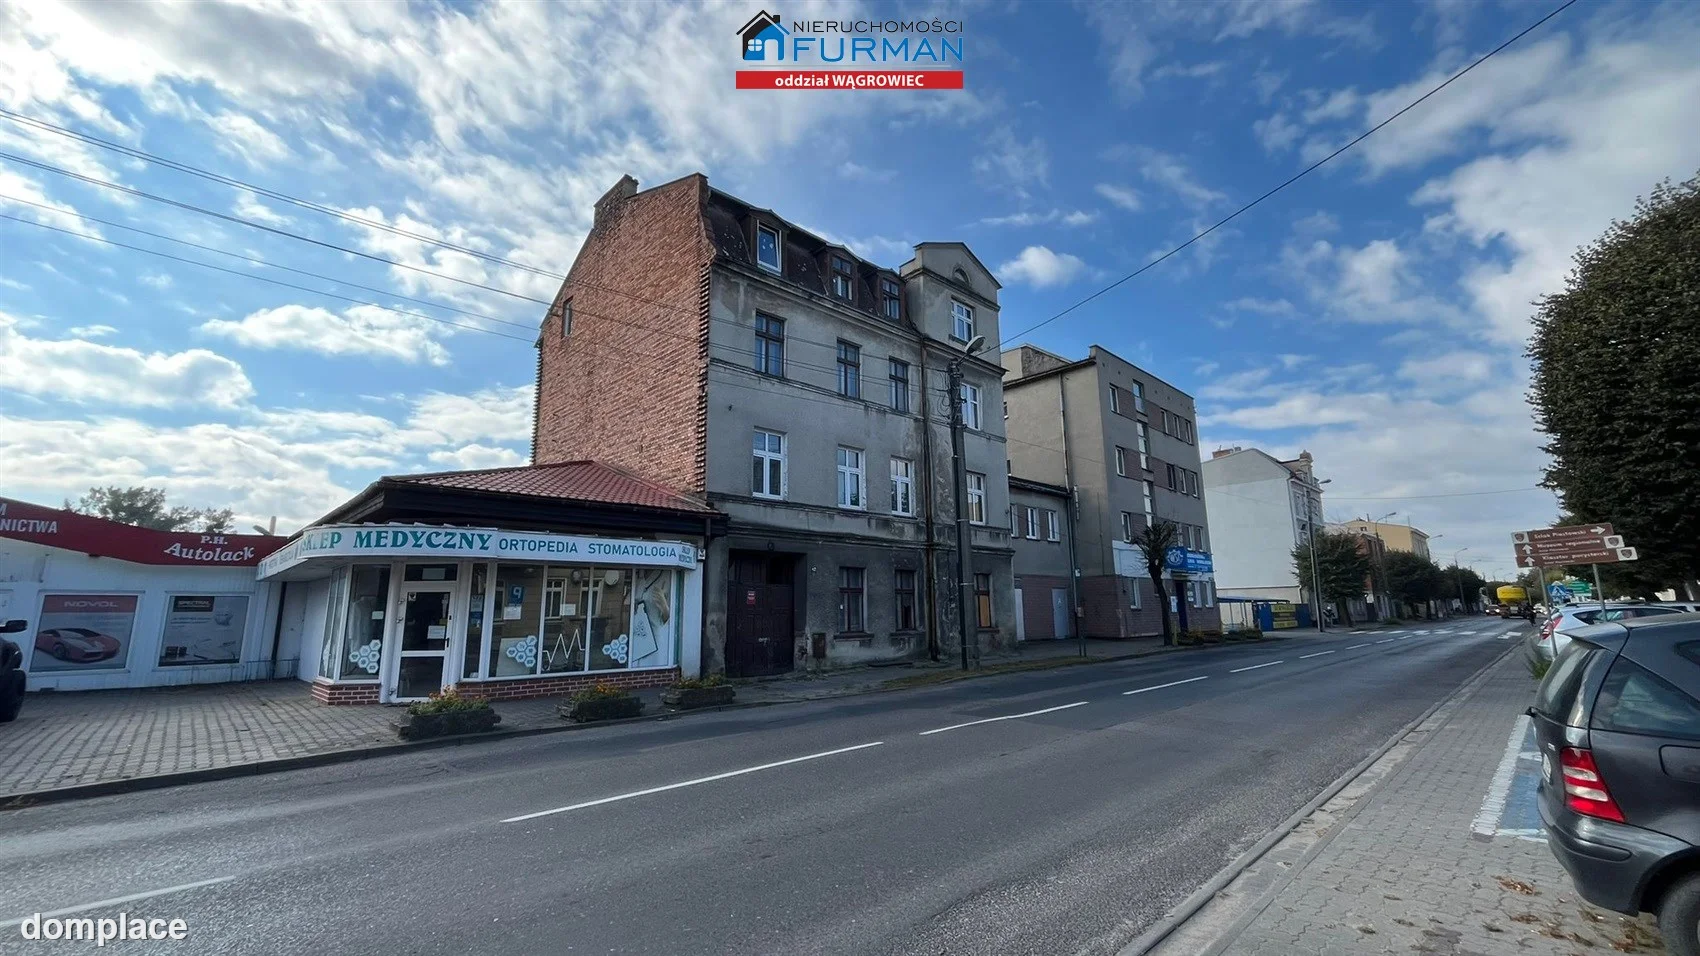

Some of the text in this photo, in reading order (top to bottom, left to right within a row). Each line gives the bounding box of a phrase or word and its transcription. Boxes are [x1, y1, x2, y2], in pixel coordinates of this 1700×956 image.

[200, 535, 228, 545] P.H.
[353, 530, 493, 550] MEDYCZNY
[498, 538, 578, 554] ORTOPEDIA
[587, 542, 677, 557] STOMATOLOGIA
[163, 542, 255, 561] Autolack
[64, 600, 118, 608] NOVOL
